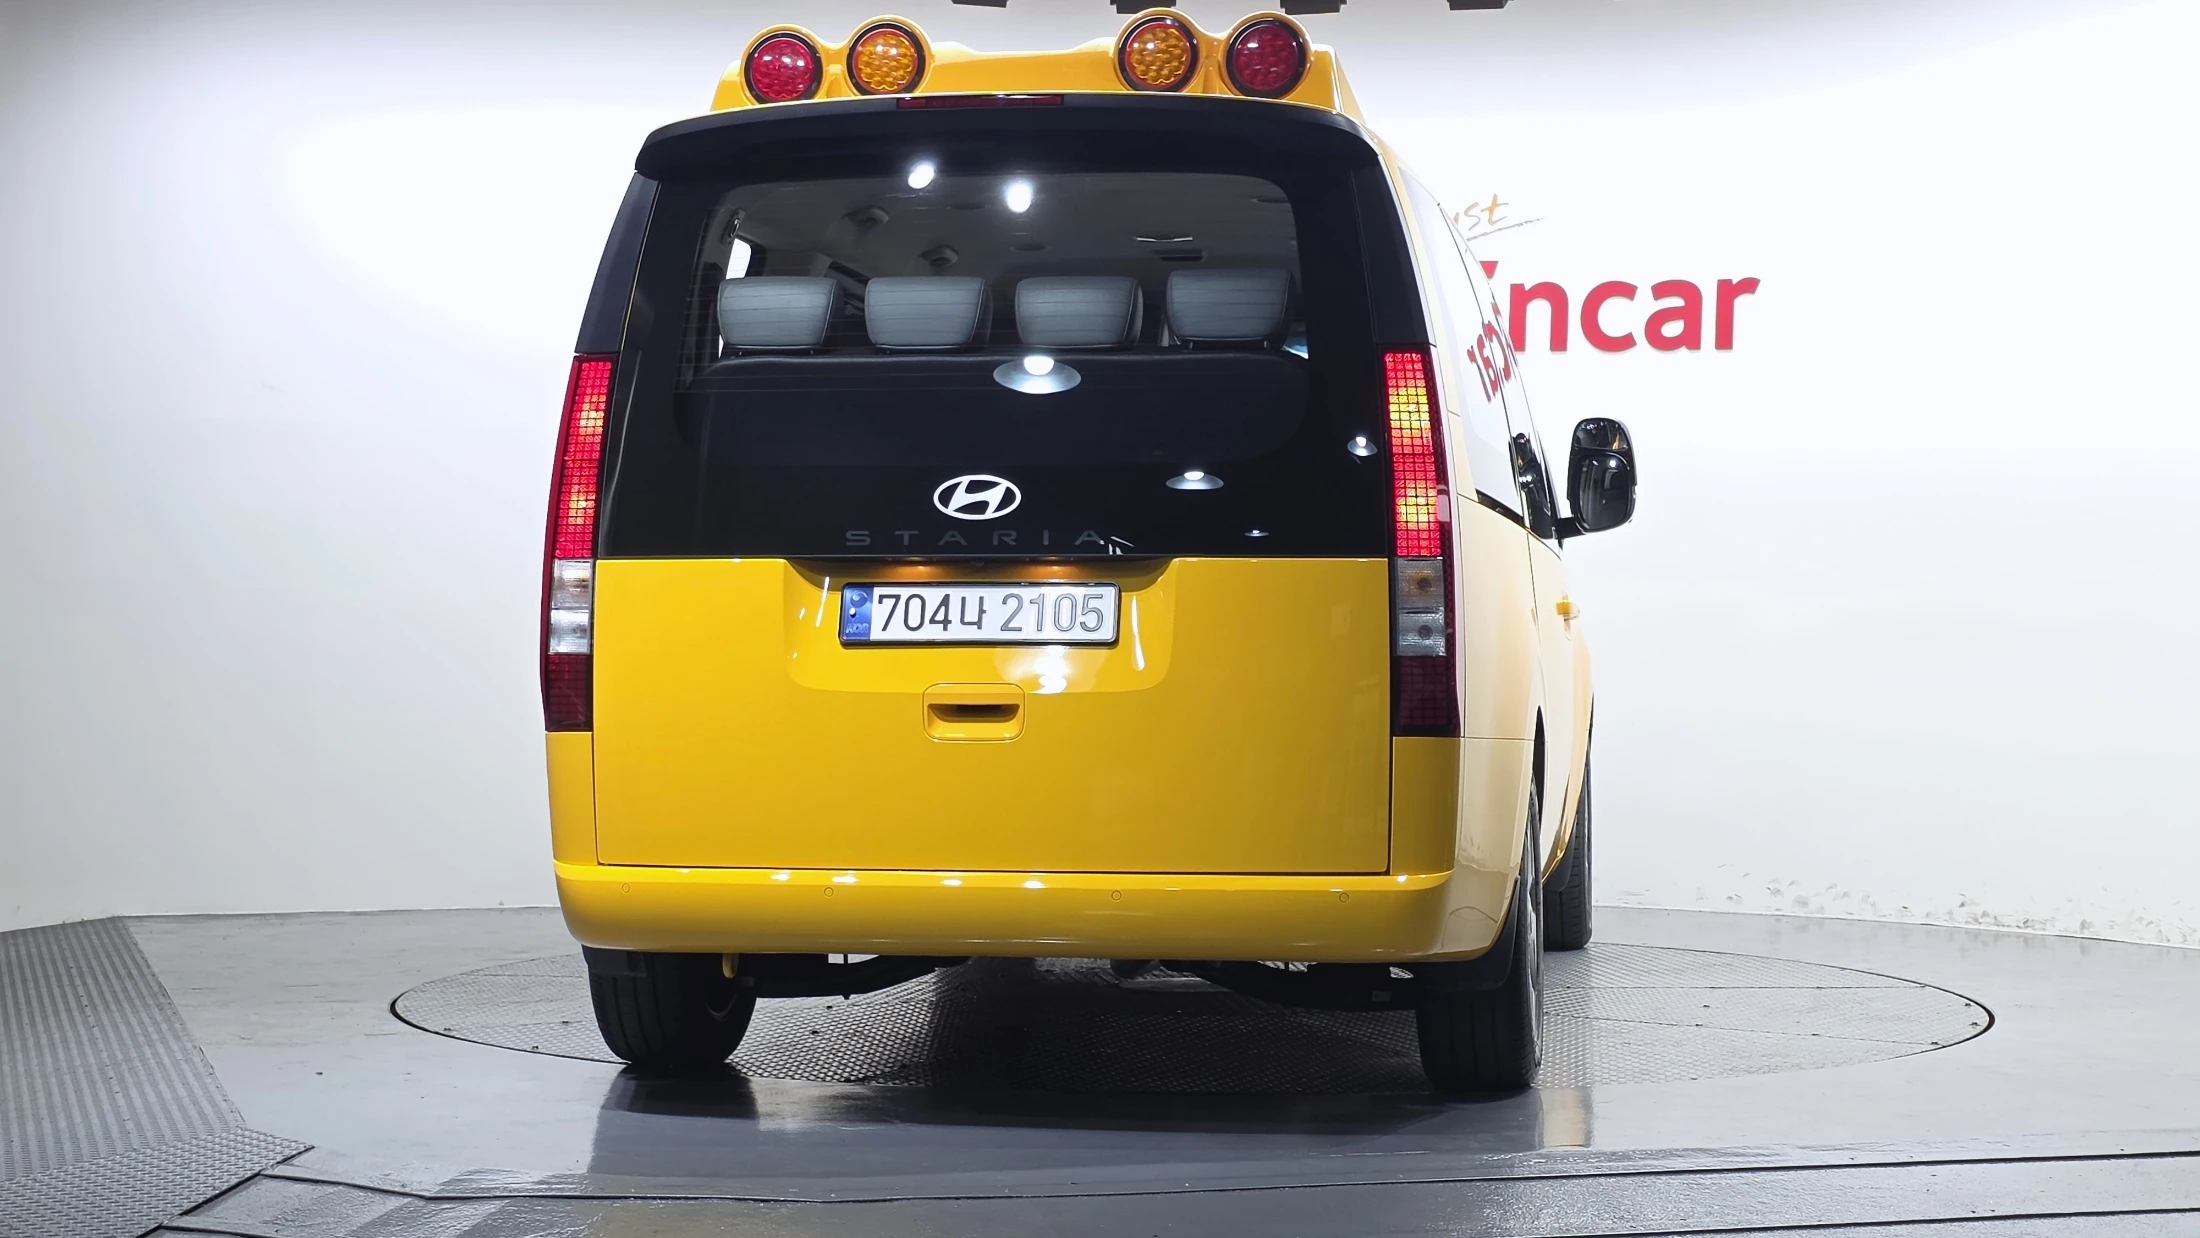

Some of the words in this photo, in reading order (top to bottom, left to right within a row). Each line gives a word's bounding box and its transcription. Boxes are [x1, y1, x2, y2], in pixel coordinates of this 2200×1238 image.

[1454, 194, 1508, 231] st
[1479, 260, 1760, 353] ncar
[845, 530, 1103, 546] STARIA
[877, 593, 987, 632] 704나
[1000, 593, 1104, 632] 2105
